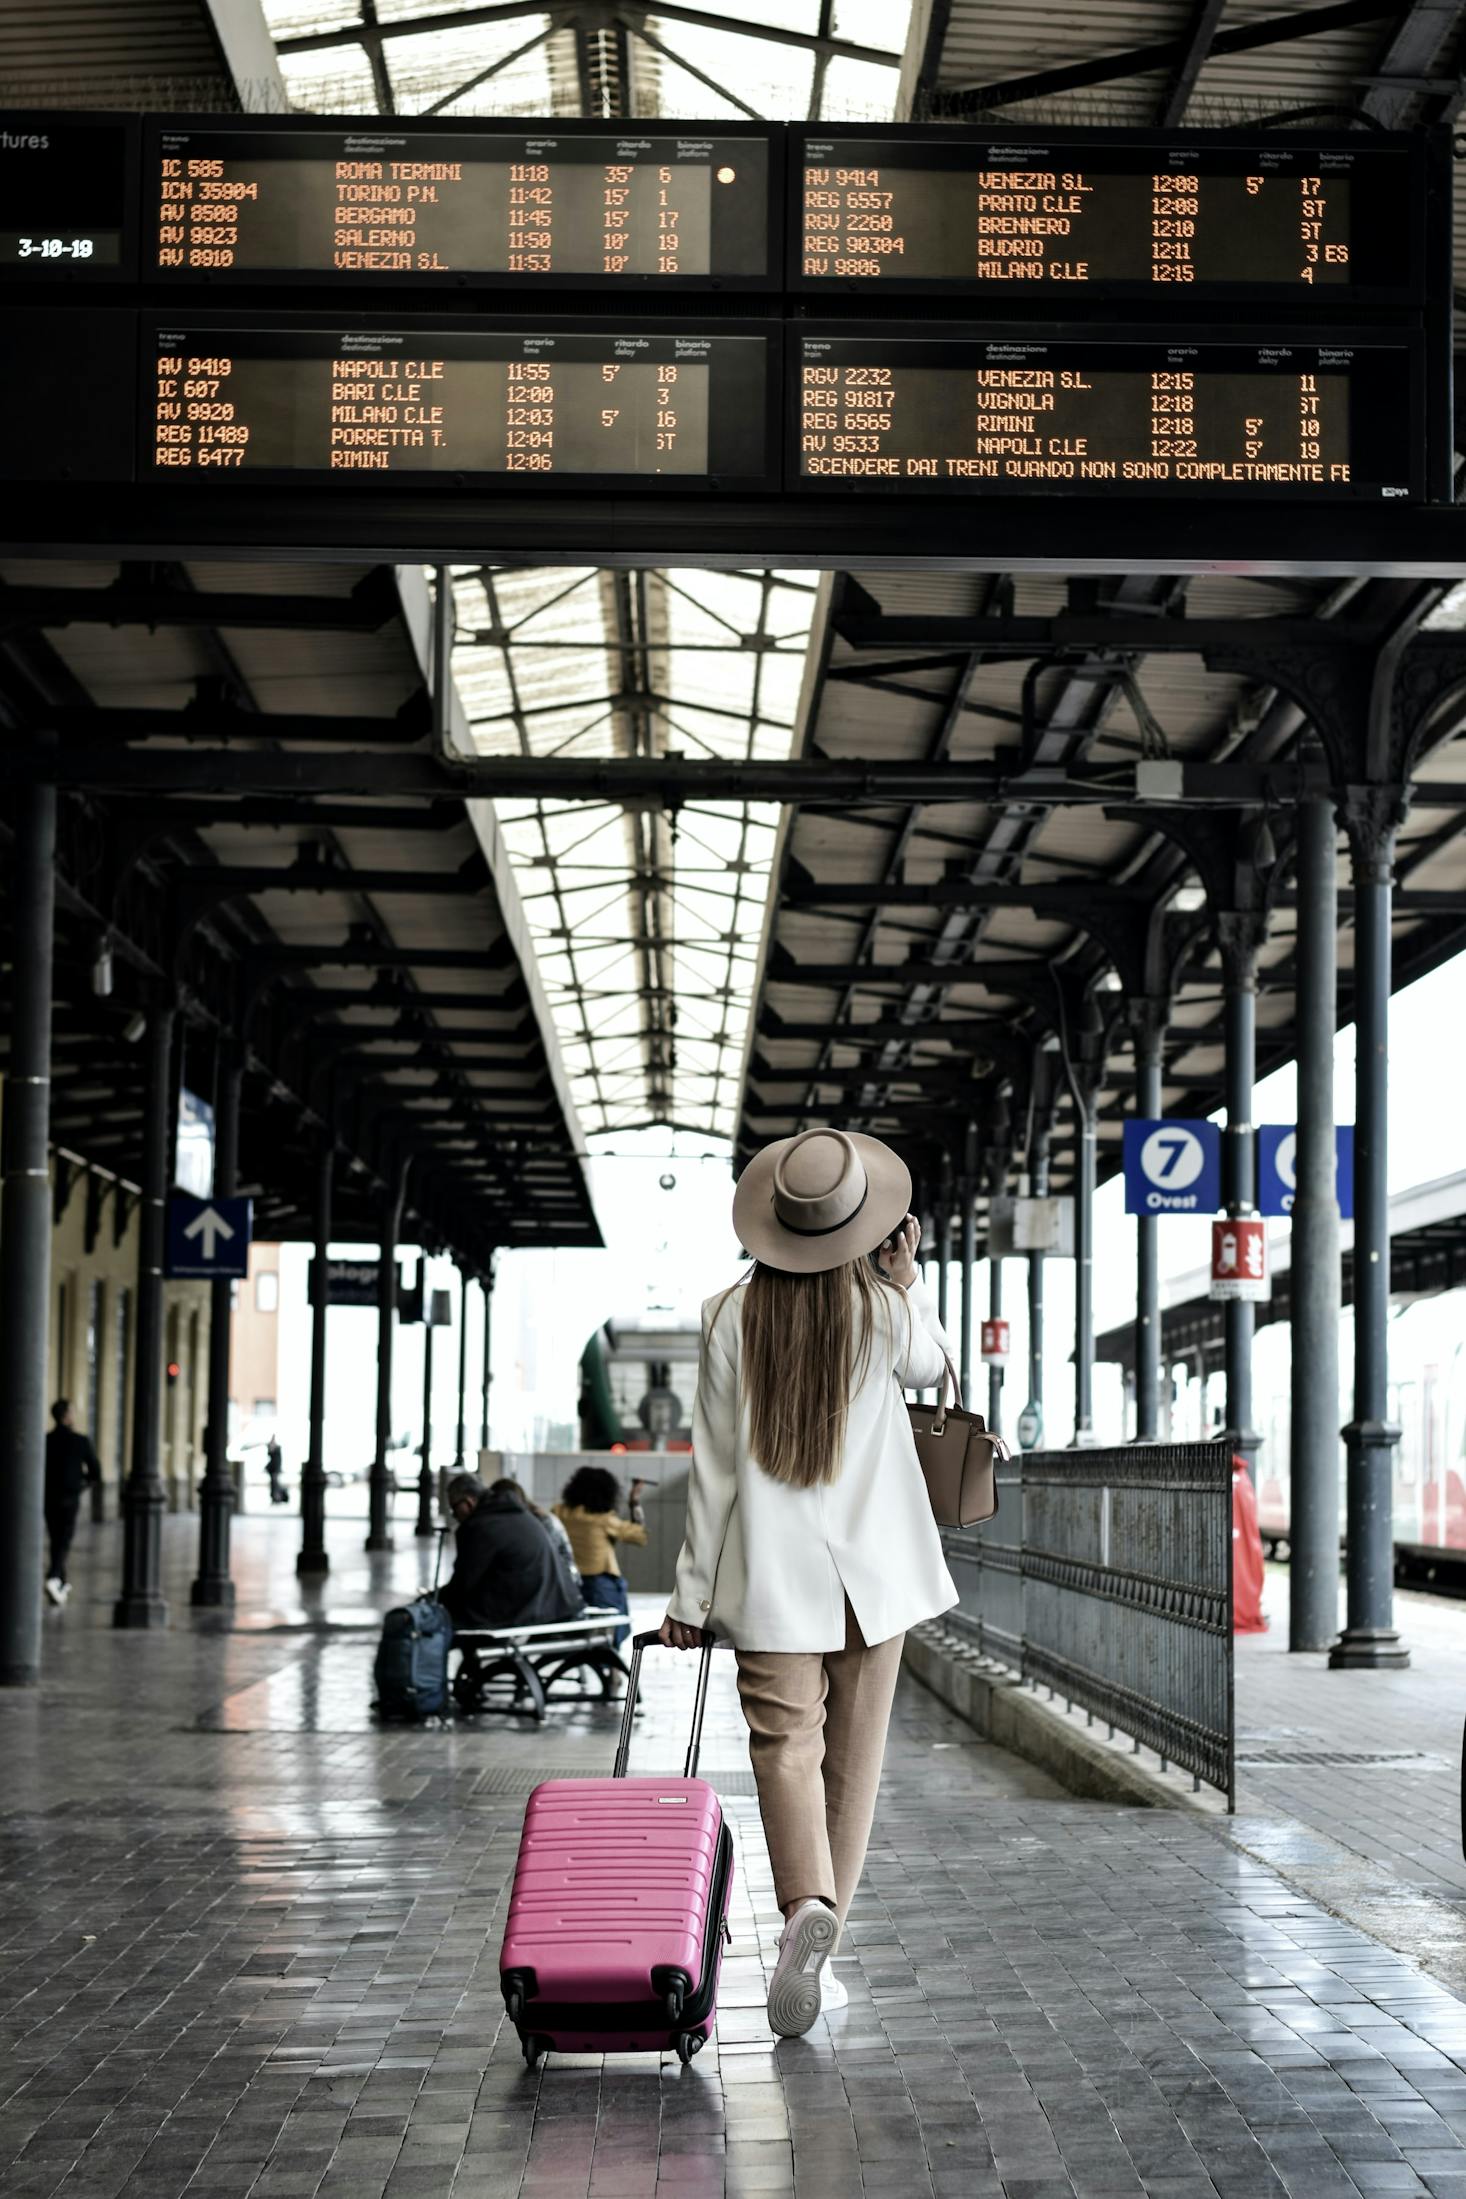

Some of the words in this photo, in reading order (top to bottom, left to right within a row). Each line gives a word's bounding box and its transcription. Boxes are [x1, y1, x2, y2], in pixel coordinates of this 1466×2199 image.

[0, 131, 49, 149] tures
[161, 159, 181, 177] IC
[188, 160, 224, 178] 585
[336, 162, 382, 180] ROMA
[389, 163, 462, 180] TERMINI
[509, 165, 549, 182] 11:18
[806, 169, 830, 186] AV
[836, 170, 878, 186] 9414
[978, 172, 1056, 190] VENEZIA
[1062, 174, 1094, 191] S.L.
[1300, 178, 1320, 195] 17
[161, 182, 193, 200] ICN
[336, 185, 401, 202] TORINO
[509, 187, 552, 204] 11:42
[805, 192, 840, 208] REG
[847, 192, 893, 209] 6557
[978, 195, 1037, 212] PRATO
[1302, 200, 1326, 217] ST
[160, 204, 184, 222] AV
[335, 207, 416, 224] BERGAMO
[509, 210, 552, 226] 11:45
[659, 212, 678, 228] 17
[805, 214, 840, 230] RGV
[847, 215, 893, 231] 2260
[978, 217, 1070, 234] BRENNERO
[160, 226, 184, 244] AV
[334, 229, 416, 246] SALERNO
[508, 232, 552, 248] 11:50
[659, 233, 678, 251] 19
[805, 236, 840, 252] REG
[846, 236, 904, 254] 90304
[978, 239, 1044, 256] BUDRIO
[1152, 242, 1191, 259] 12:11
[1325, 245, 1349, 262] ES
[160, 248, 184, 266] AV
[334, 251, 411, 269] VENEZIA
[508, 254, 551, 271] 11:53
[658, 256, 678, 273] 16
[805, 258, 827, 275] AV
[835, 259, 880, 276] 9806
[978, 261, 1043, 279] MILANO
[1152, 264, 1194, 282] 12:15
[158, 358, 182, 376] AV
[188, 358, 232, 376] 9419
[332, 361, 398, 378] NAPOLI
[507, 363, 550, 380] 11:55
[657, 366, 677, 383] 18
[803, 368, 838, 384] RGV
[845, 368, 892, 385] 2232
[977, 370, 1054, 388] VENEZIA
[1061, 371, 1092, 388] S.L.
[1151, 373, 1194, 390] 12:15
[1300, 374, 1316, 392] 11
[158, 380, 178, 398] IC
[184, 380, 220, 398] 607
[332, 384, 376, 400] BARI
[507, 386, 554, 403] 12:00
[803, 390, 838, 407] REG
[845, 391, 895, 408] 91817
[977, 393, 1054, 410] VIGNOLA
[1151, 395, 1194, 412] 12:18
[157, 402, 182, 420] AV
[187, 403, 234, 421] 9920
[332, 406, 398, 423] MILANO
[507, 408, 553, 425] 12:03
[657, 411, 676, 428] 16
[803, 413, 837, 429] REG
[845, 413, 891, 430] 6565
[977, 415, 1035, 432] RIMINI
[1151, 418, 1194, 435] 12:18
[156, 425, 192, 442] REG
[331, 428, 424, 446] PORRETTA
[432, 430, 446, 446] T.
[506, 431, 553, 448] 12:04
[803, 435, 826, 451] AV
[833, 436, 880, 452] 9533
[977, 438, 1042, 455] NAPOLI
[1151, 440, 1197, 457] 12:22
[1300, 442, 1320, 459] 19
[156, 448, 191, 466] REG
[198, 449, 244, 466] 6477
[330, 451, 389, 468] RIMINI
[506, 454, 552, 470] 12:06
[808, 457, 900, 475] SCENDERE
[907, 459, 938, 476] DAI
[946, 459, 998, 476] TRENI
[1006, 460, 1074, 478] QUANDO
[1081, 461, 1116, 478] NON
[1122, 462, 1168, 479] SONO
[1176, 463, 1323, 482] COMPLETAMENTE
[1158, 1140, 1189, 1177] 7
[1146, 1192, 1198, 1208] Ovest
